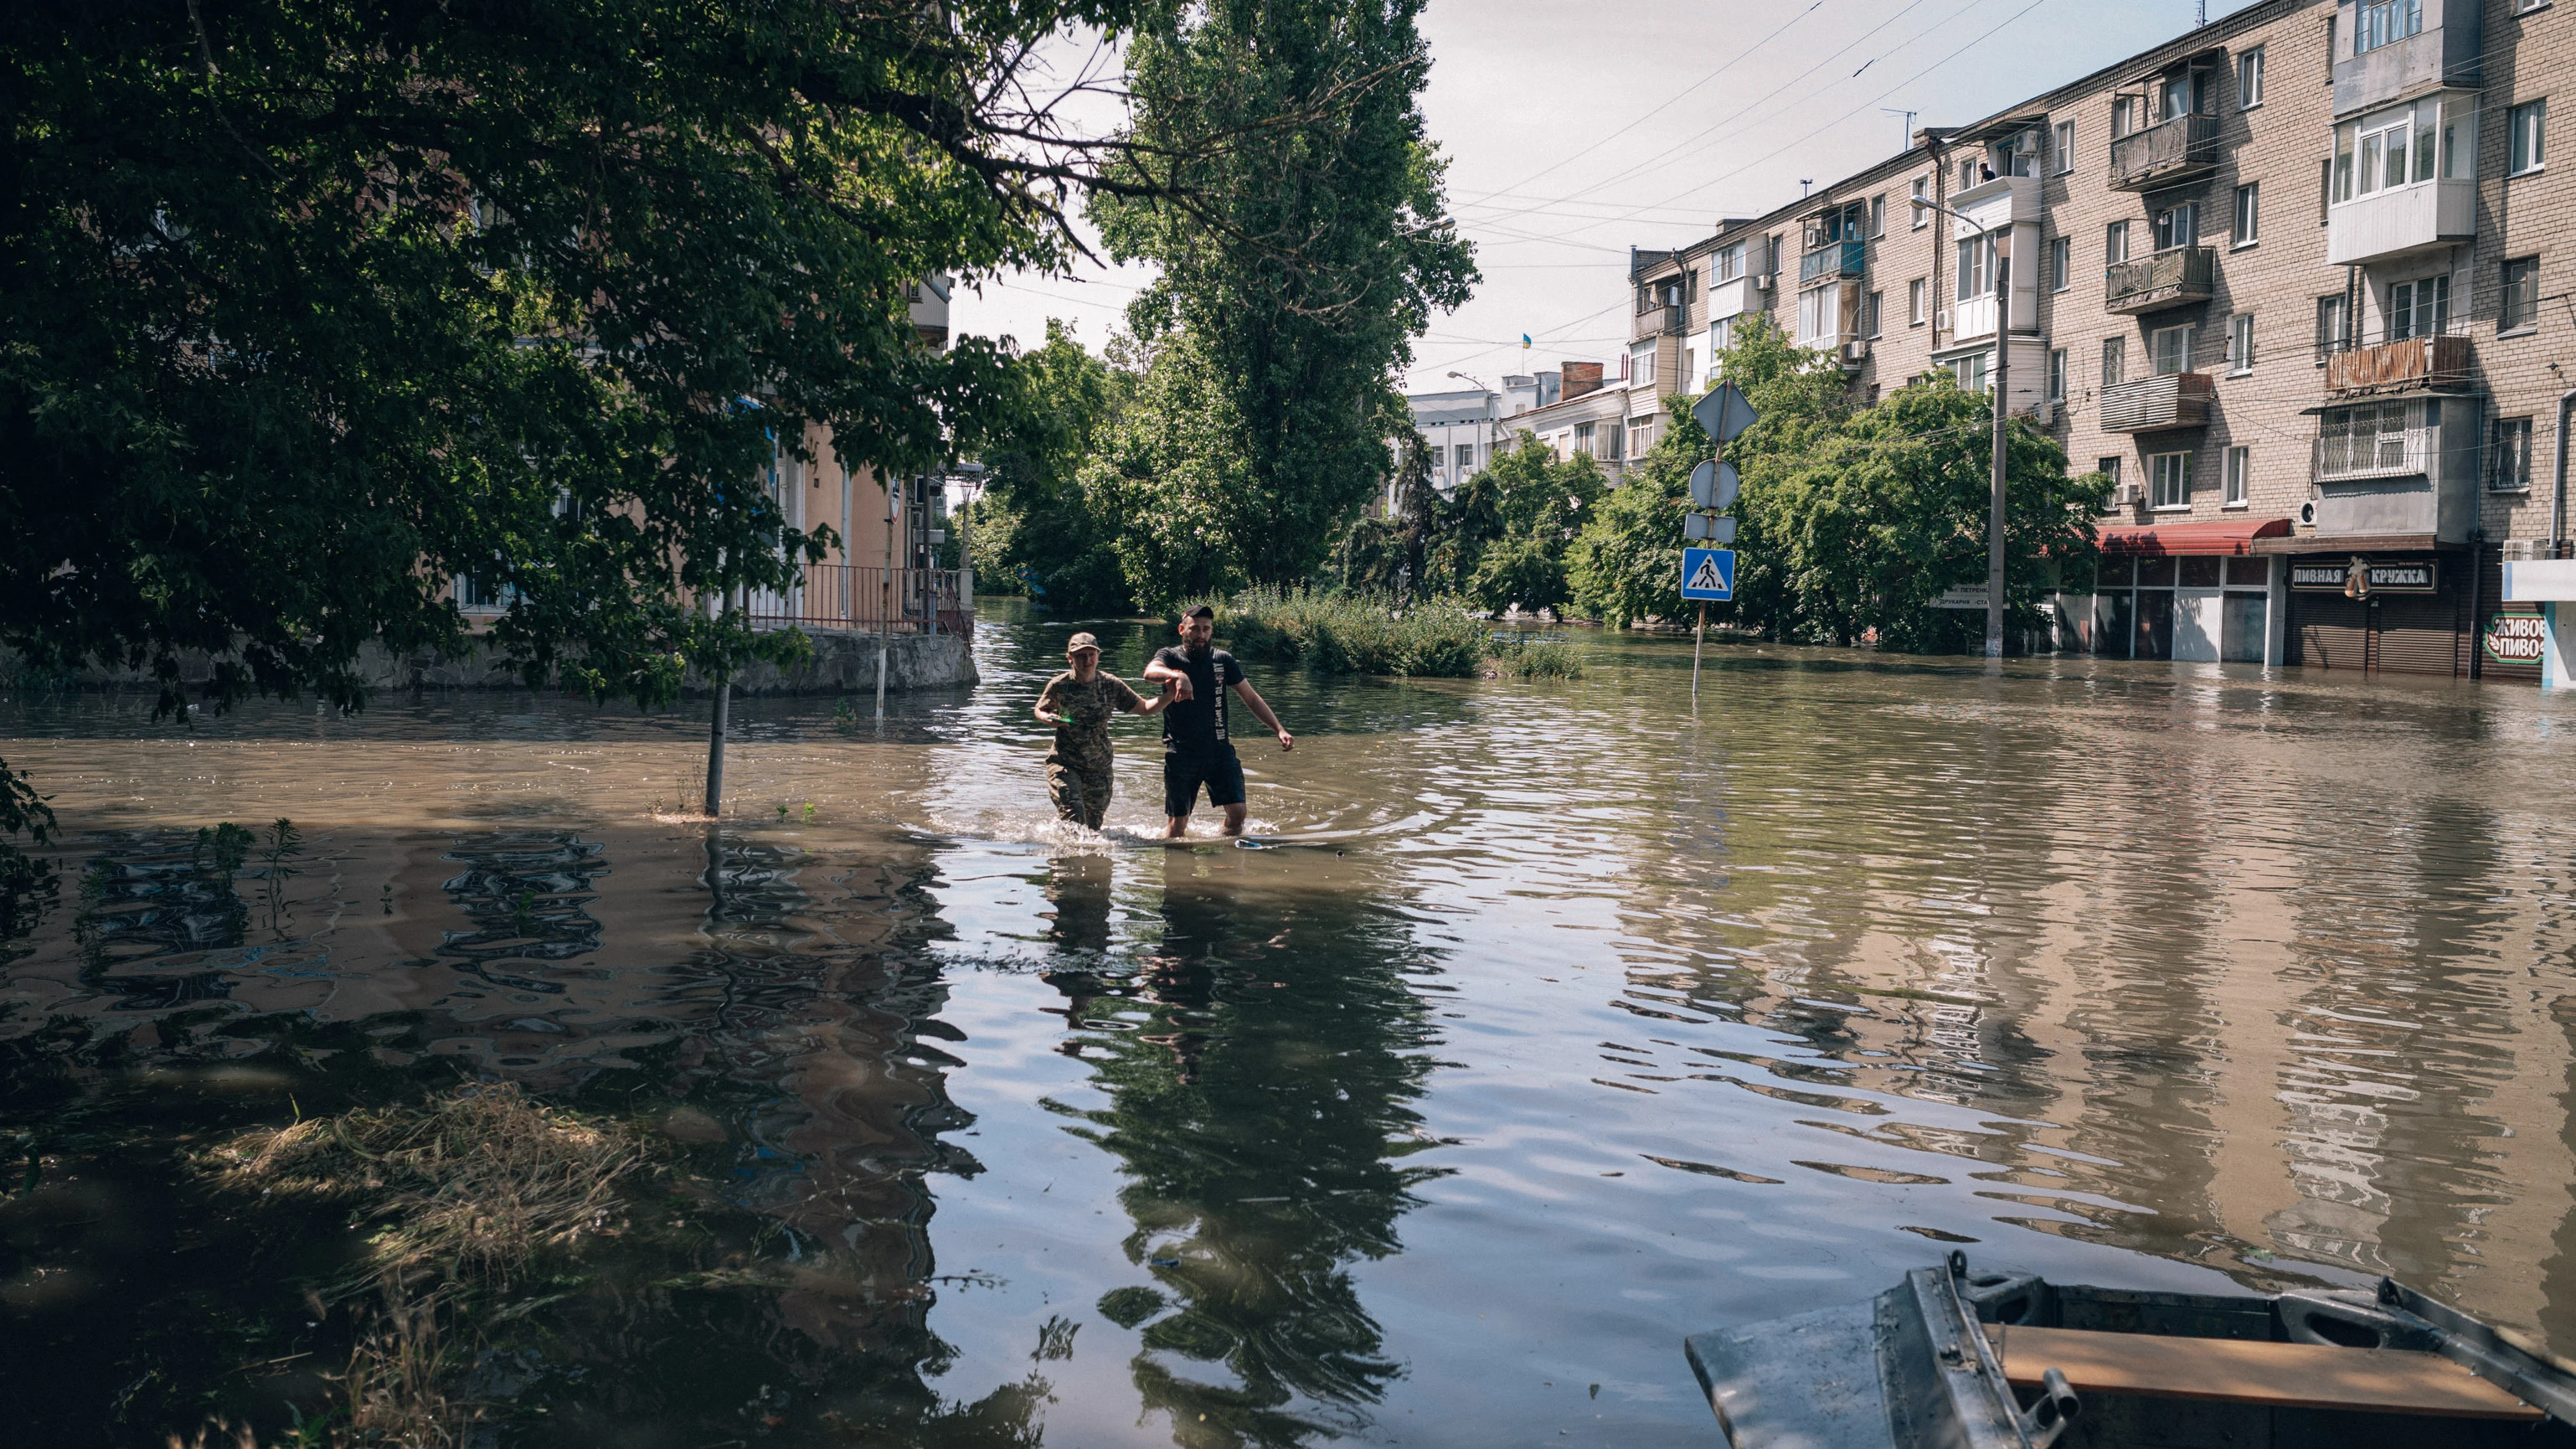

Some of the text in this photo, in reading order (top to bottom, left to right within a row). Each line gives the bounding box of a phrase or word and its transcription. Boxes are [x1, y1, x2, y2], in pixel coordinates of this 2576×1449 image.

[2294, 569, 2426, 584] ПИВНАЯ КРУЖКА
[2500, 637, 2539, 657] ПИВО
[1215, 696, 1222, 708] NO
[1215, 729, 1225, 740] NO
